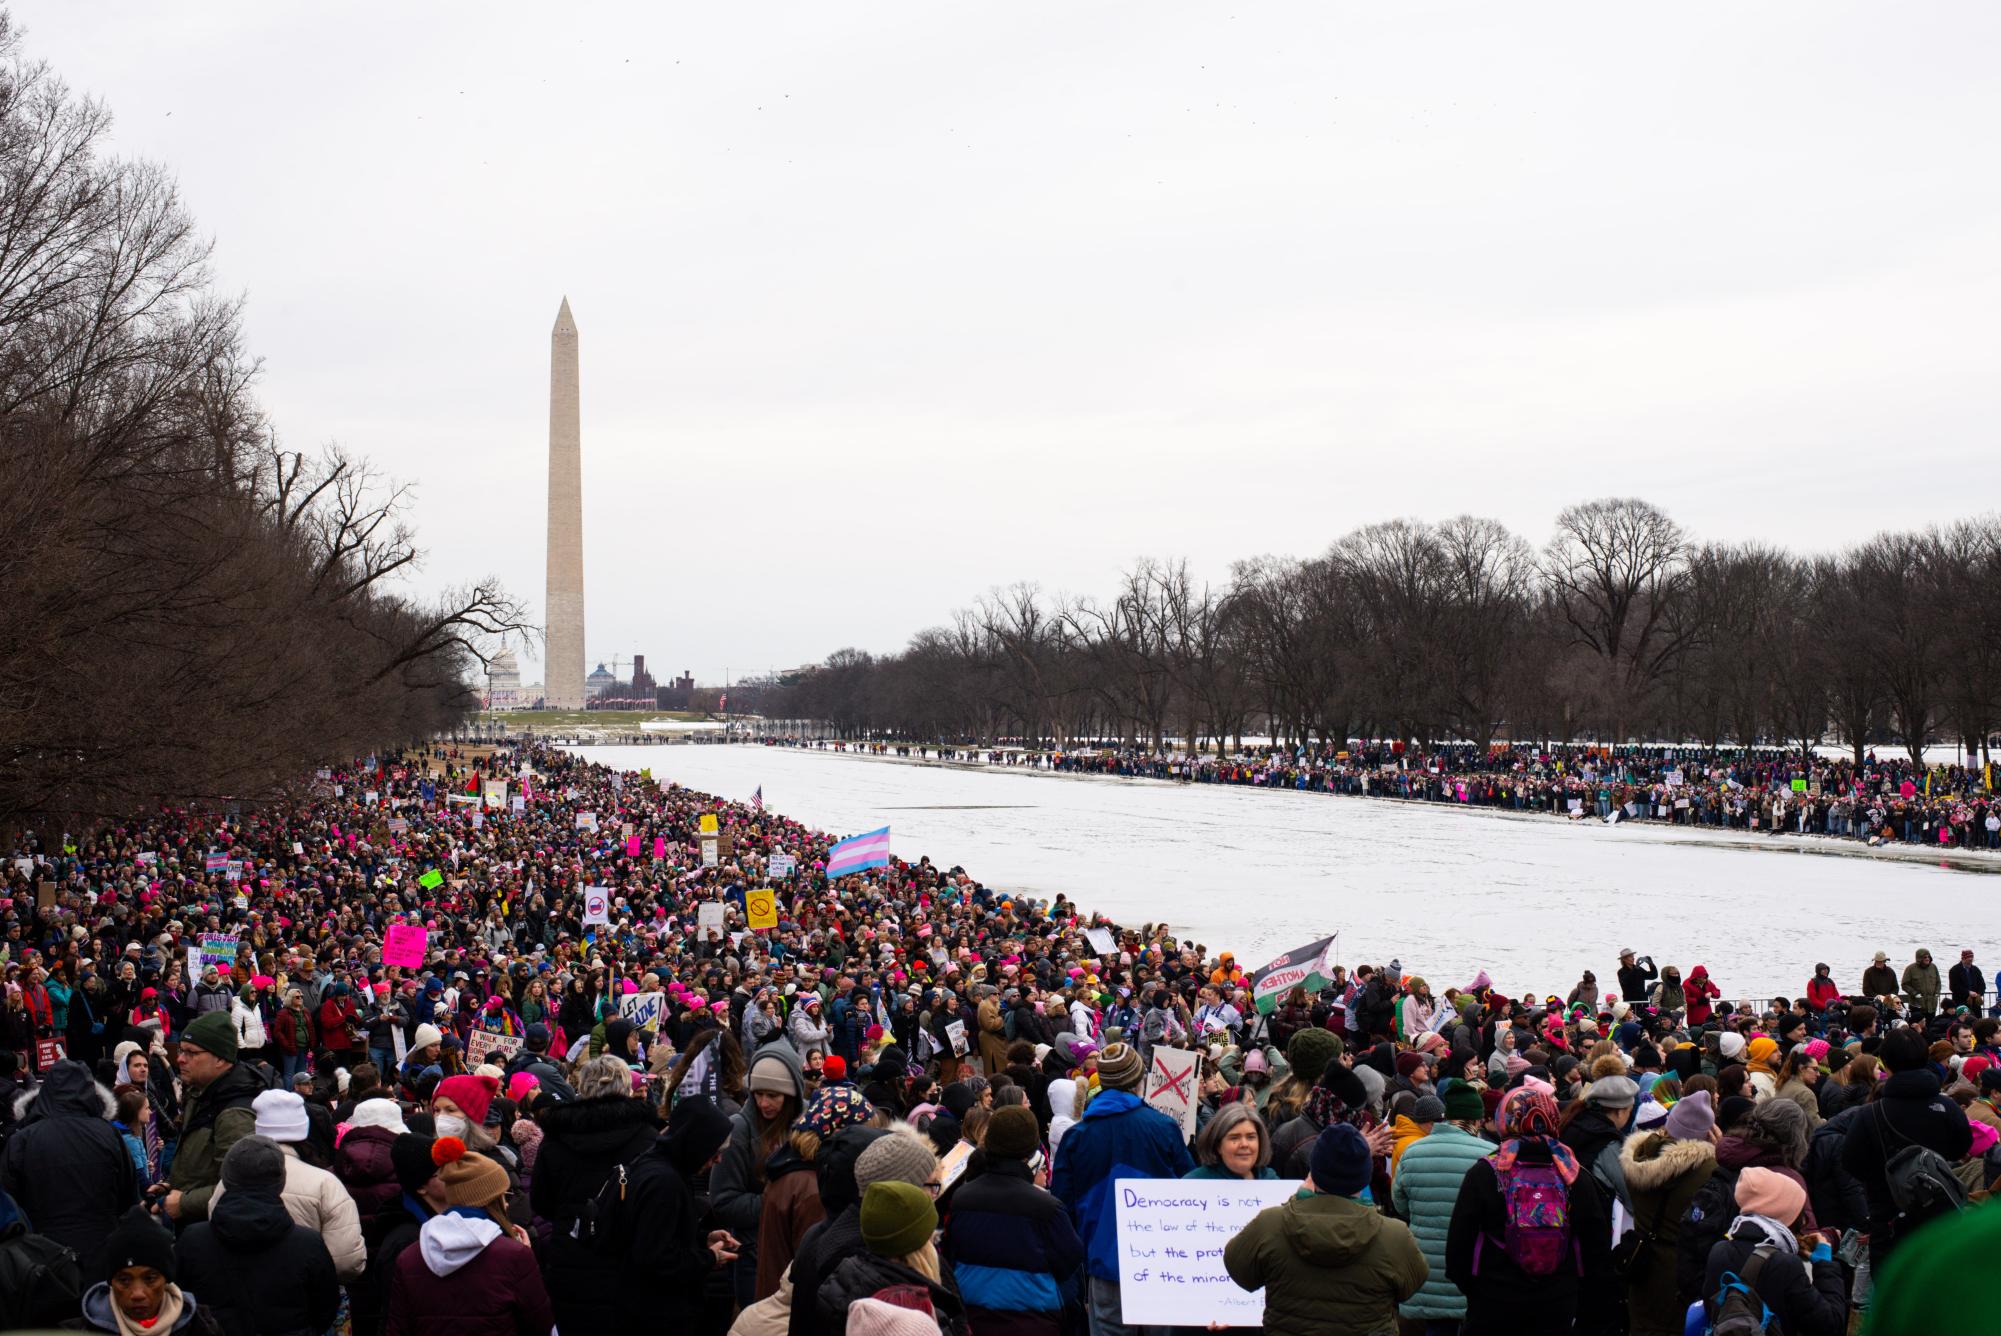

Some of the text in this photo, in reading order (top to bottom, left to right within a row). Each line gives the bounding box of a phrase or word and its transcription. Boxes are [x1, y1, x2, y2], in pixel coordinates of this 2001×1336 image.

[622, 996, 638, 1018] LET
[634, 996, 657, 1025] AINE
[471, 1039, 513, 1054] EVERY GIRL
[480, 1033, 497, 1043] WALK
[504, 1037, 518, 1046] FOR
[709, 1072, 717, 1091] THE
[1124, 1188, 1262, 1211] Democracy is not
[1127, 1219, 1153, 1232] the
[1159, 1219, 1179, 1232] law
[1185, 1219, 1198, 1232] of
[1205, 1221, 1226, 1233] the
[1130, 1242, 1224, 1261] but the prot
[1133, 1268, 1231, 1284] of the minor
